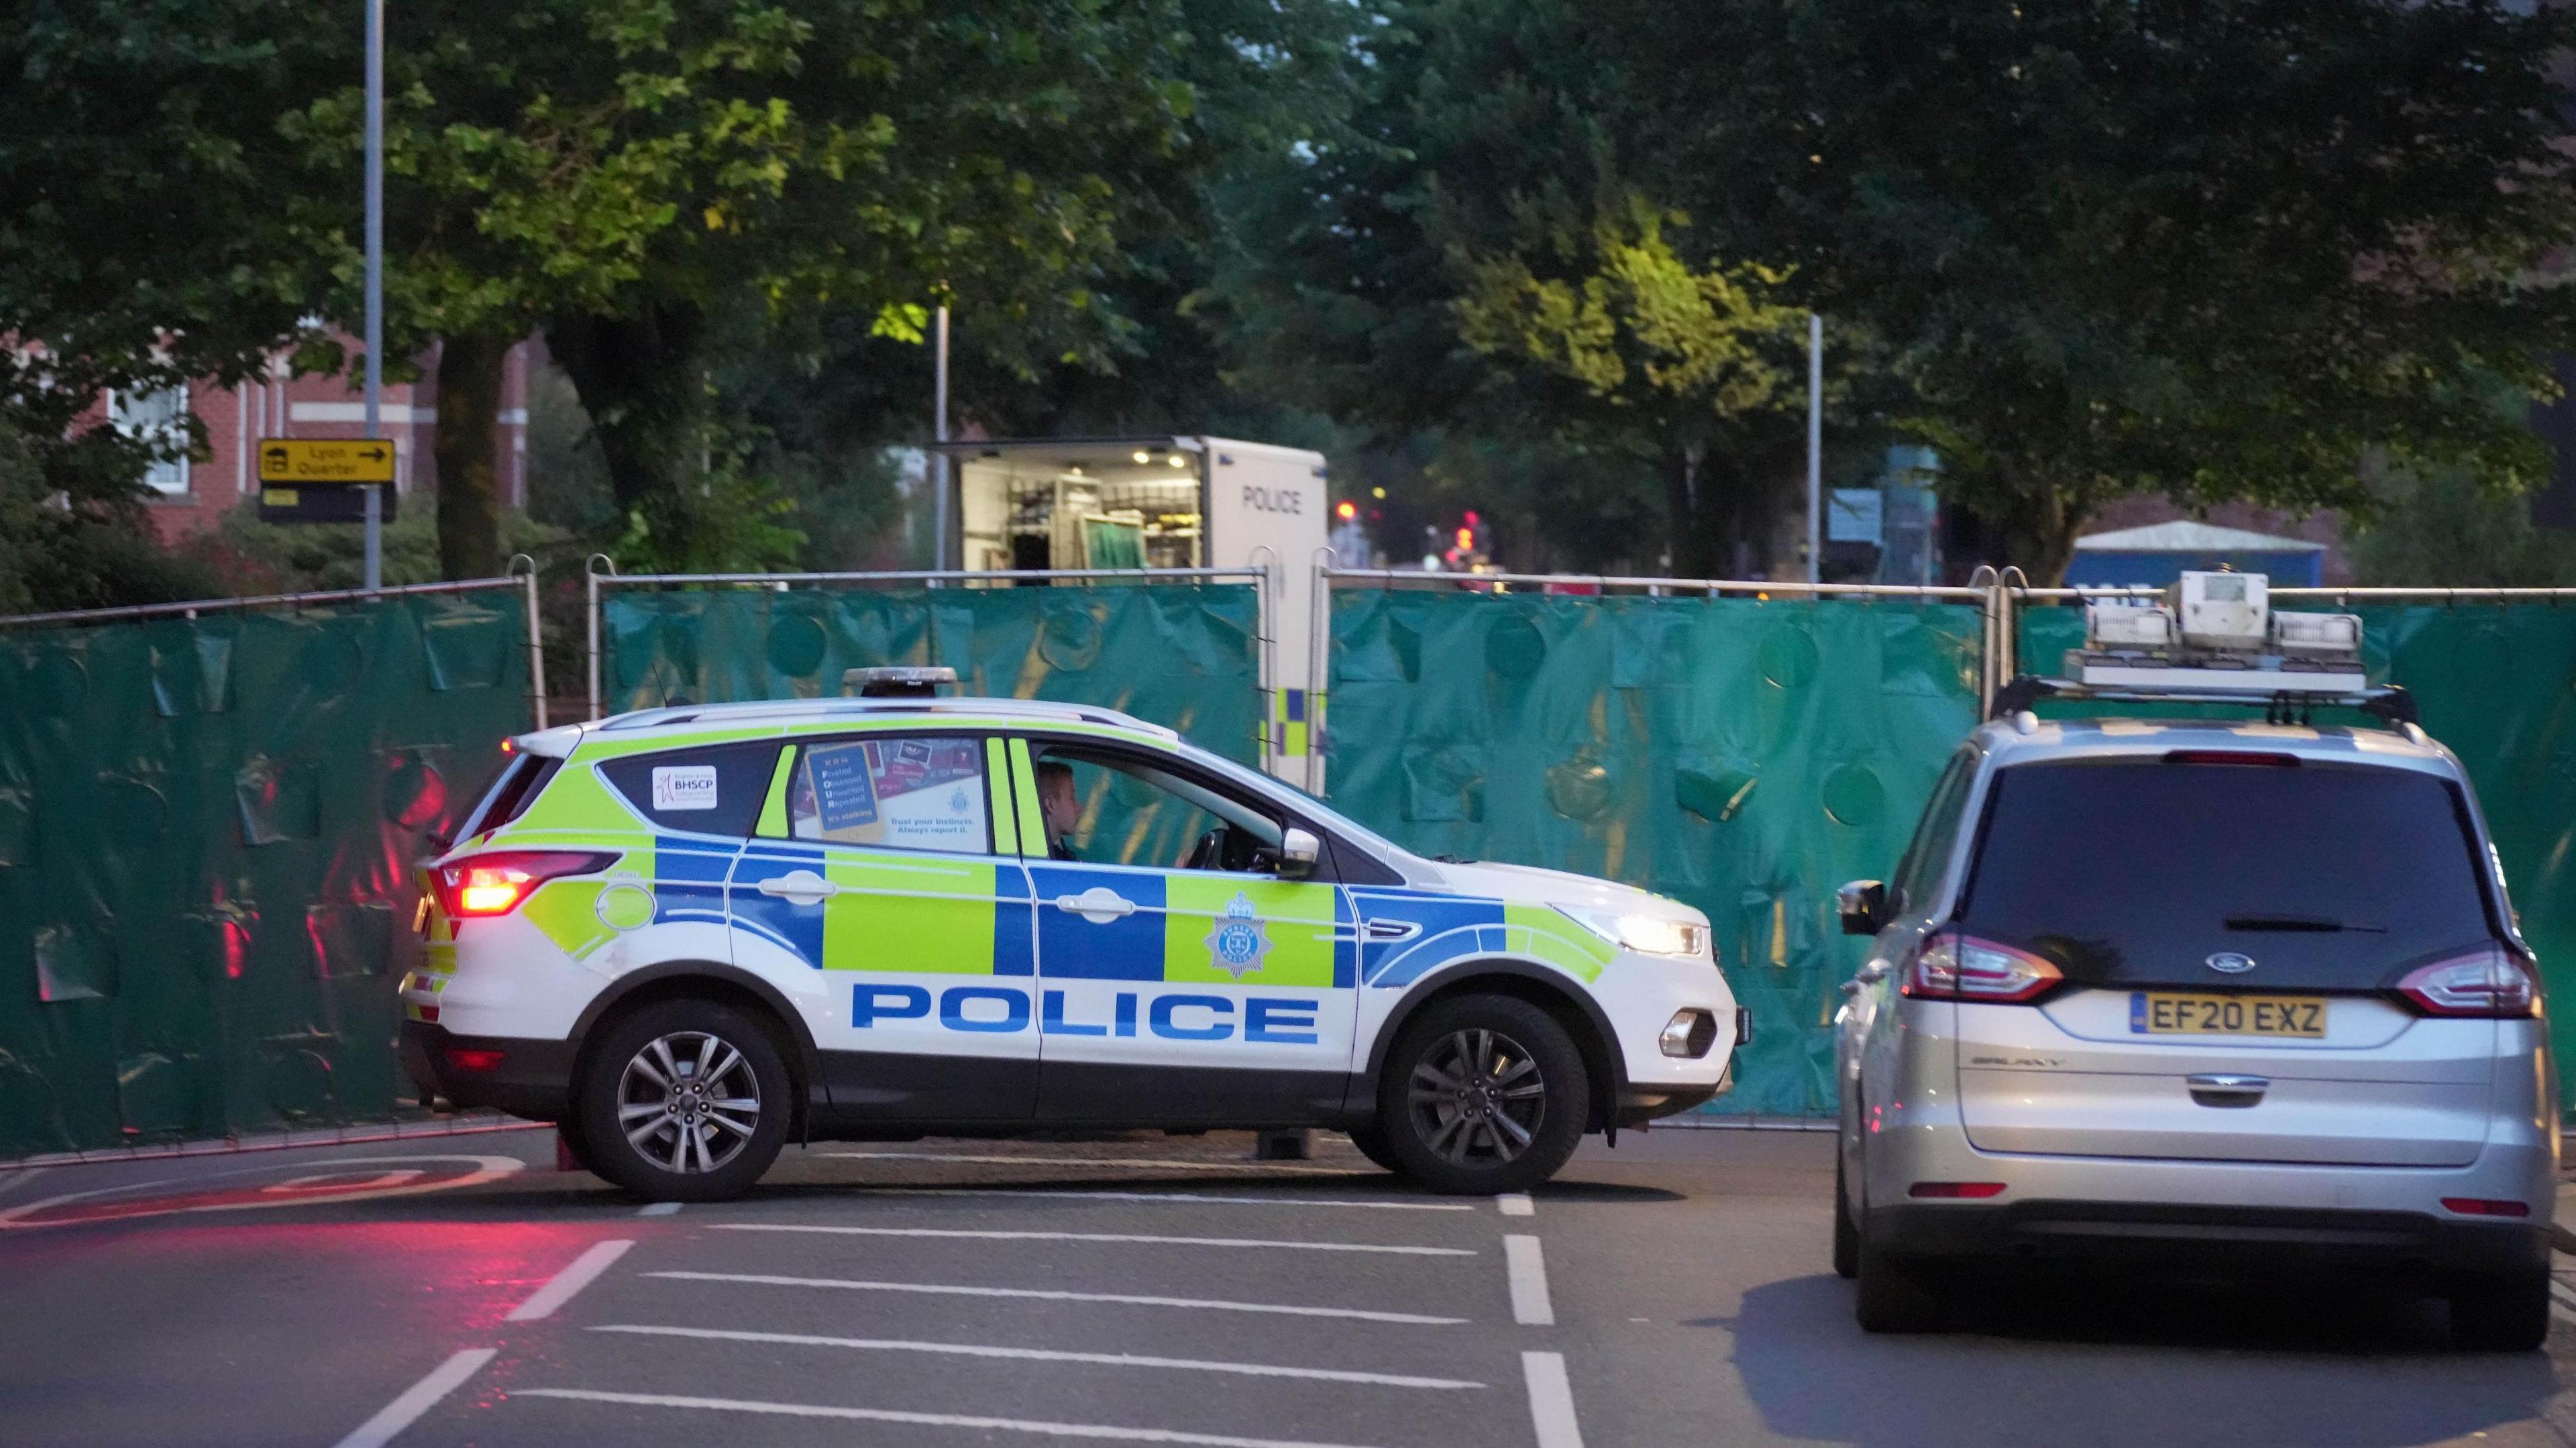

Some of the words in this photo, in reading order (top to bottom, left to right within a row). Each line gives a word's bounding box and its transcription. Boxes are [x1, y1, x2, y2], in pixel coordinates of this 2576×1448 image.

[309, 445, 347, 461] Lyon
[297, 462, 358, 476] Quarter
[1242, 484, 1301, 515] POLICE
[822, 767, 852, 779] Fixated
[675, 780, 713, 789] BHSCP
[823, 774, 862, 789] Obsessed
[825, 785, 865, 798] Unwanted
[827, 795, 866, 808] Repeated
[898, 826, 928, 834] Always
[1222, 950, 1253, 963] POLICE
[851, 983, 1319, 1044] POLICE
[2153, 1000, 2243, 1030] EF20
[2254, 1003, 2322, 1032] EXZ
